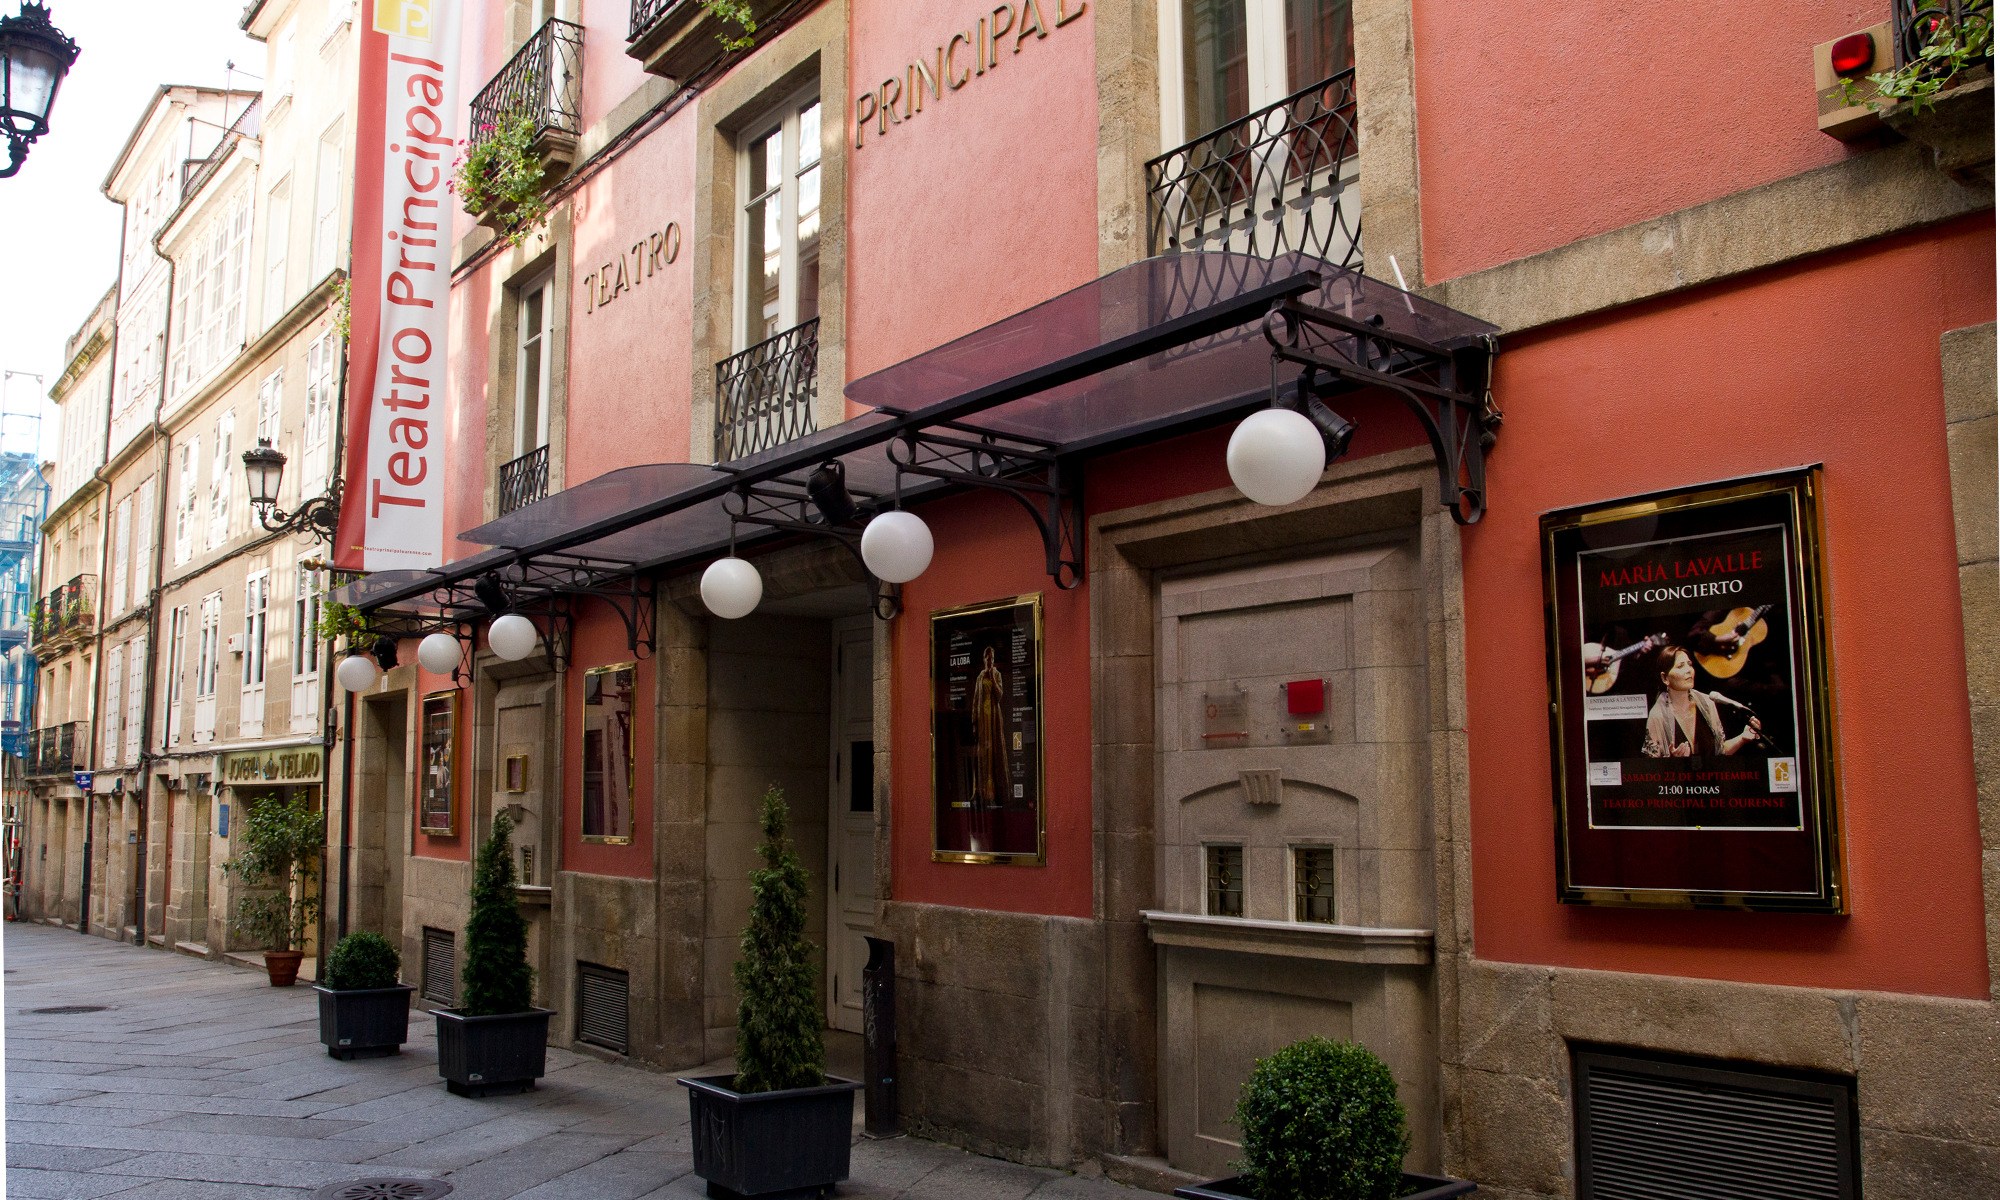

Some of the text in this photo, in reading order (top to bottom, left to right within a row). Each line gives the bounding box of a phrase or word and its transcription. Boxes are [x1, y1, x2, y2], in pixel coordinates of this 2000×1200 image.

[584, 221, 681, 315] TEATRO
[372, 53, 454, 519] Teatro Principal
[1600, 550, 1763, 588] MARÍA LAVALLE
[1618, 579, 1744, 606] EN CONCIERTO
[950, 656, 971, 667] LA LOBA
[279, 751, 320, 779] TELMO
[1663, 771, 1675, 781] 22
[1678, 771, 1693, 781] DE
[1695, 771, 1760, 781] SEPTIEMBRE
[1603, 797, 1785, 808] TEATRO PRINCIPAL DE OURENSE
[1658, 785, 1720, 795] 21:00 HORAS
